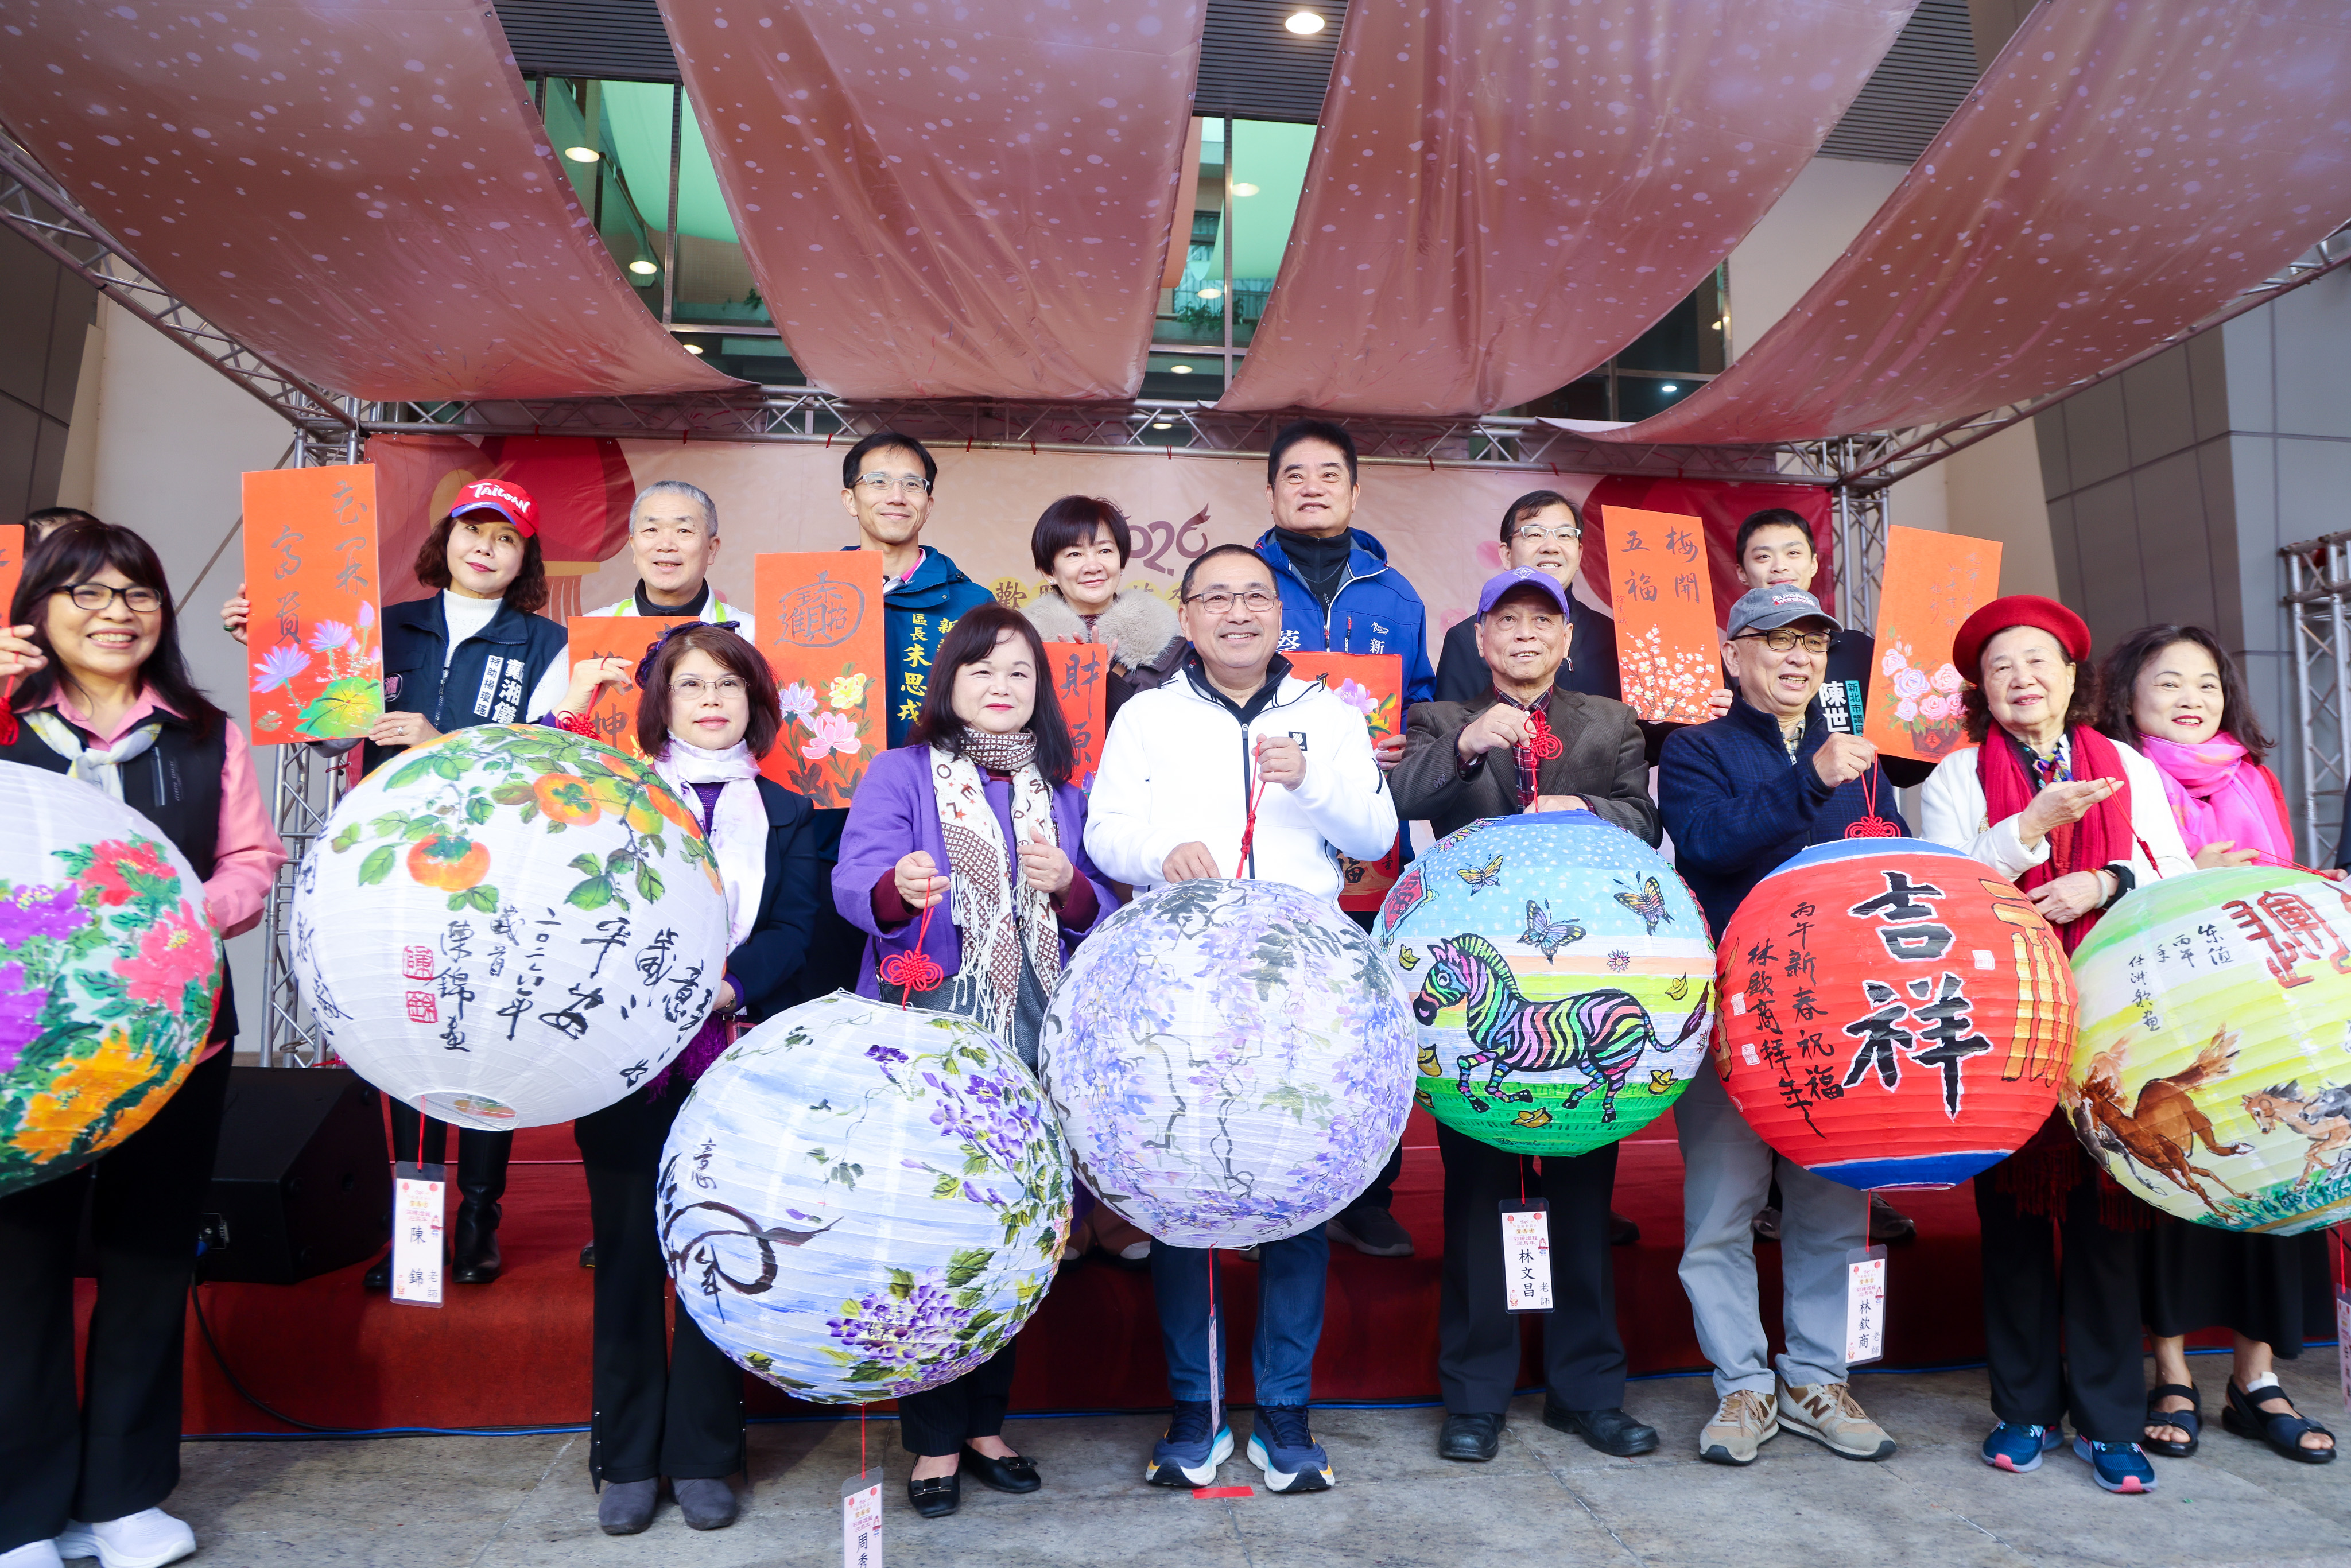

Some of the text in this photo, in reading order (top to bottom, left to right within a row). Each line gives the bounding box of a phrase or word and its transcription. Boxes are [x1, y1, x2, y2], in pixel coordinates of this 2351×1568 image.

[1620, 530, 1658, 603] 五福
[1665, 526, 1700, 604] 梅開
[491, 658, 526, 724] 戴湘儀
[1847, 682, 1864, 734] 新北市議員
[1784, 902, 1844, 1100] 丙午新春祝福
[1842, 870, 1994, 1123] 吉祥
[1519, 1248, 1536, 1297] 林文昌
[1539, 1282, 1550, 1307] 老師
